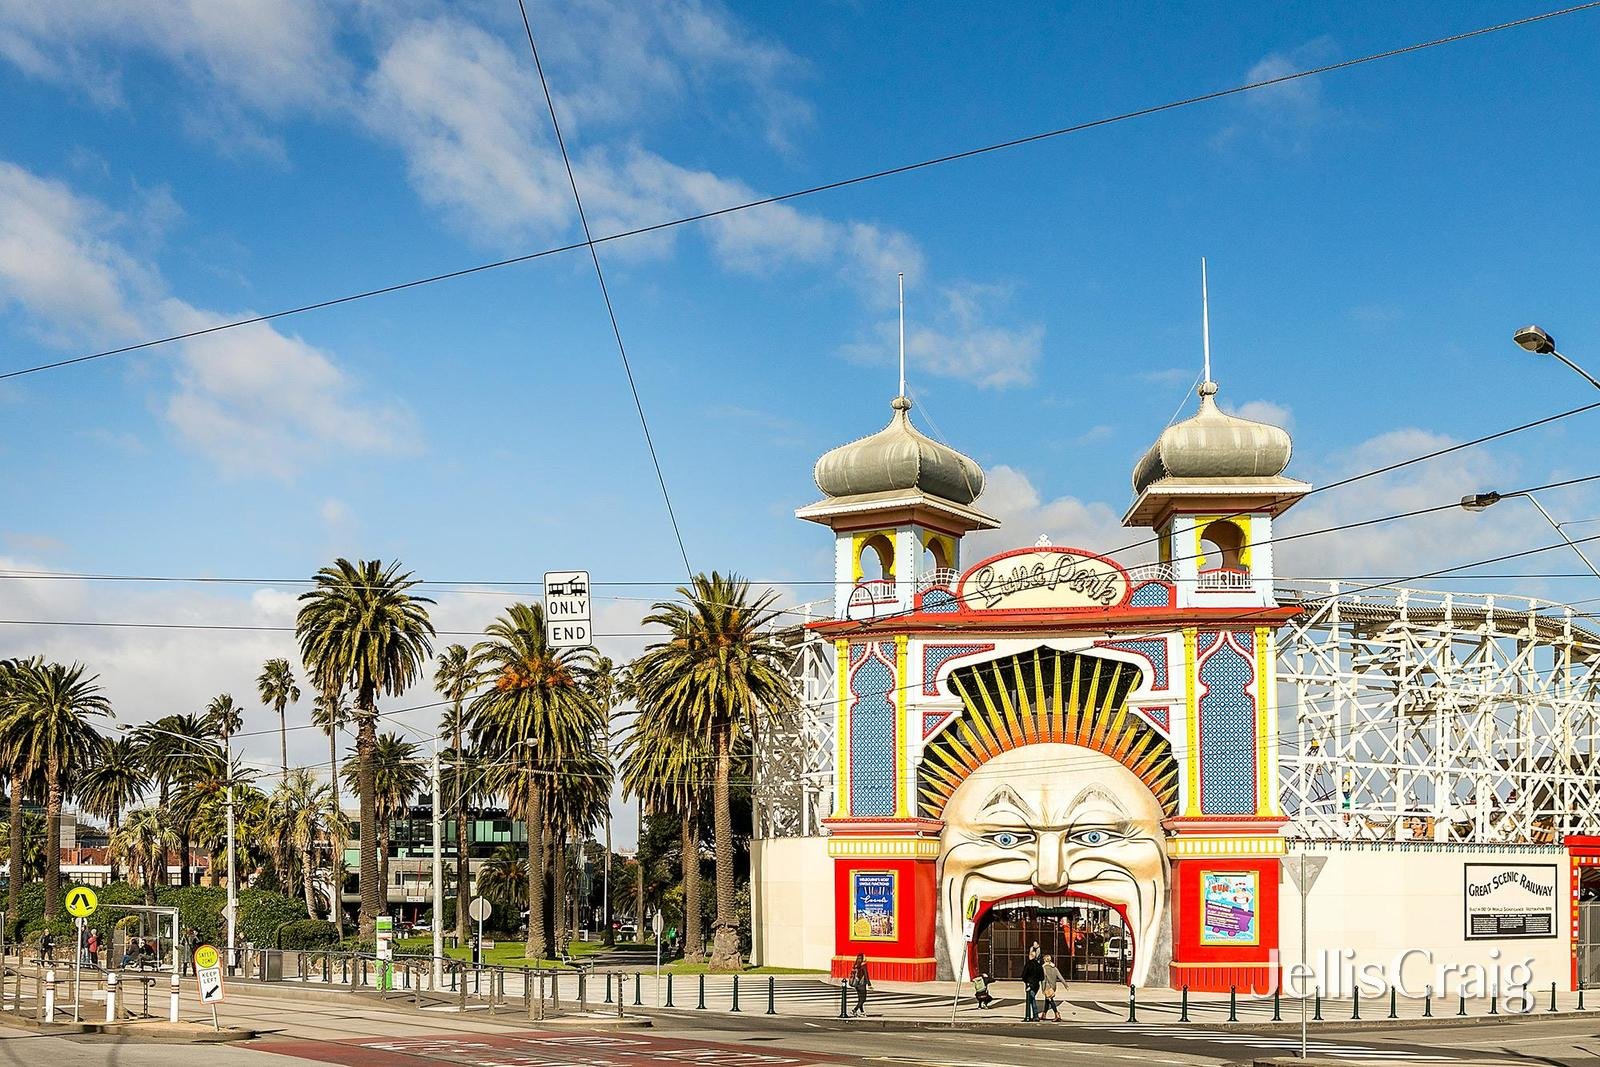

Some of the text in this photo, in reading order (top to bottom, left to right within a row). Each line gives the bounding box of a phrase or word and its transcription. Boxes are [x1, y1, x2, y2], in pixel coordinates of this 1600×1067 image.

[1048, 554, 1118, 605] Park
[550, 600, 586, 615] ONLY
[553, 627, 586, 640] END
[1468, 871, 1553, 897] GREAT SCENIC RAILWAY
